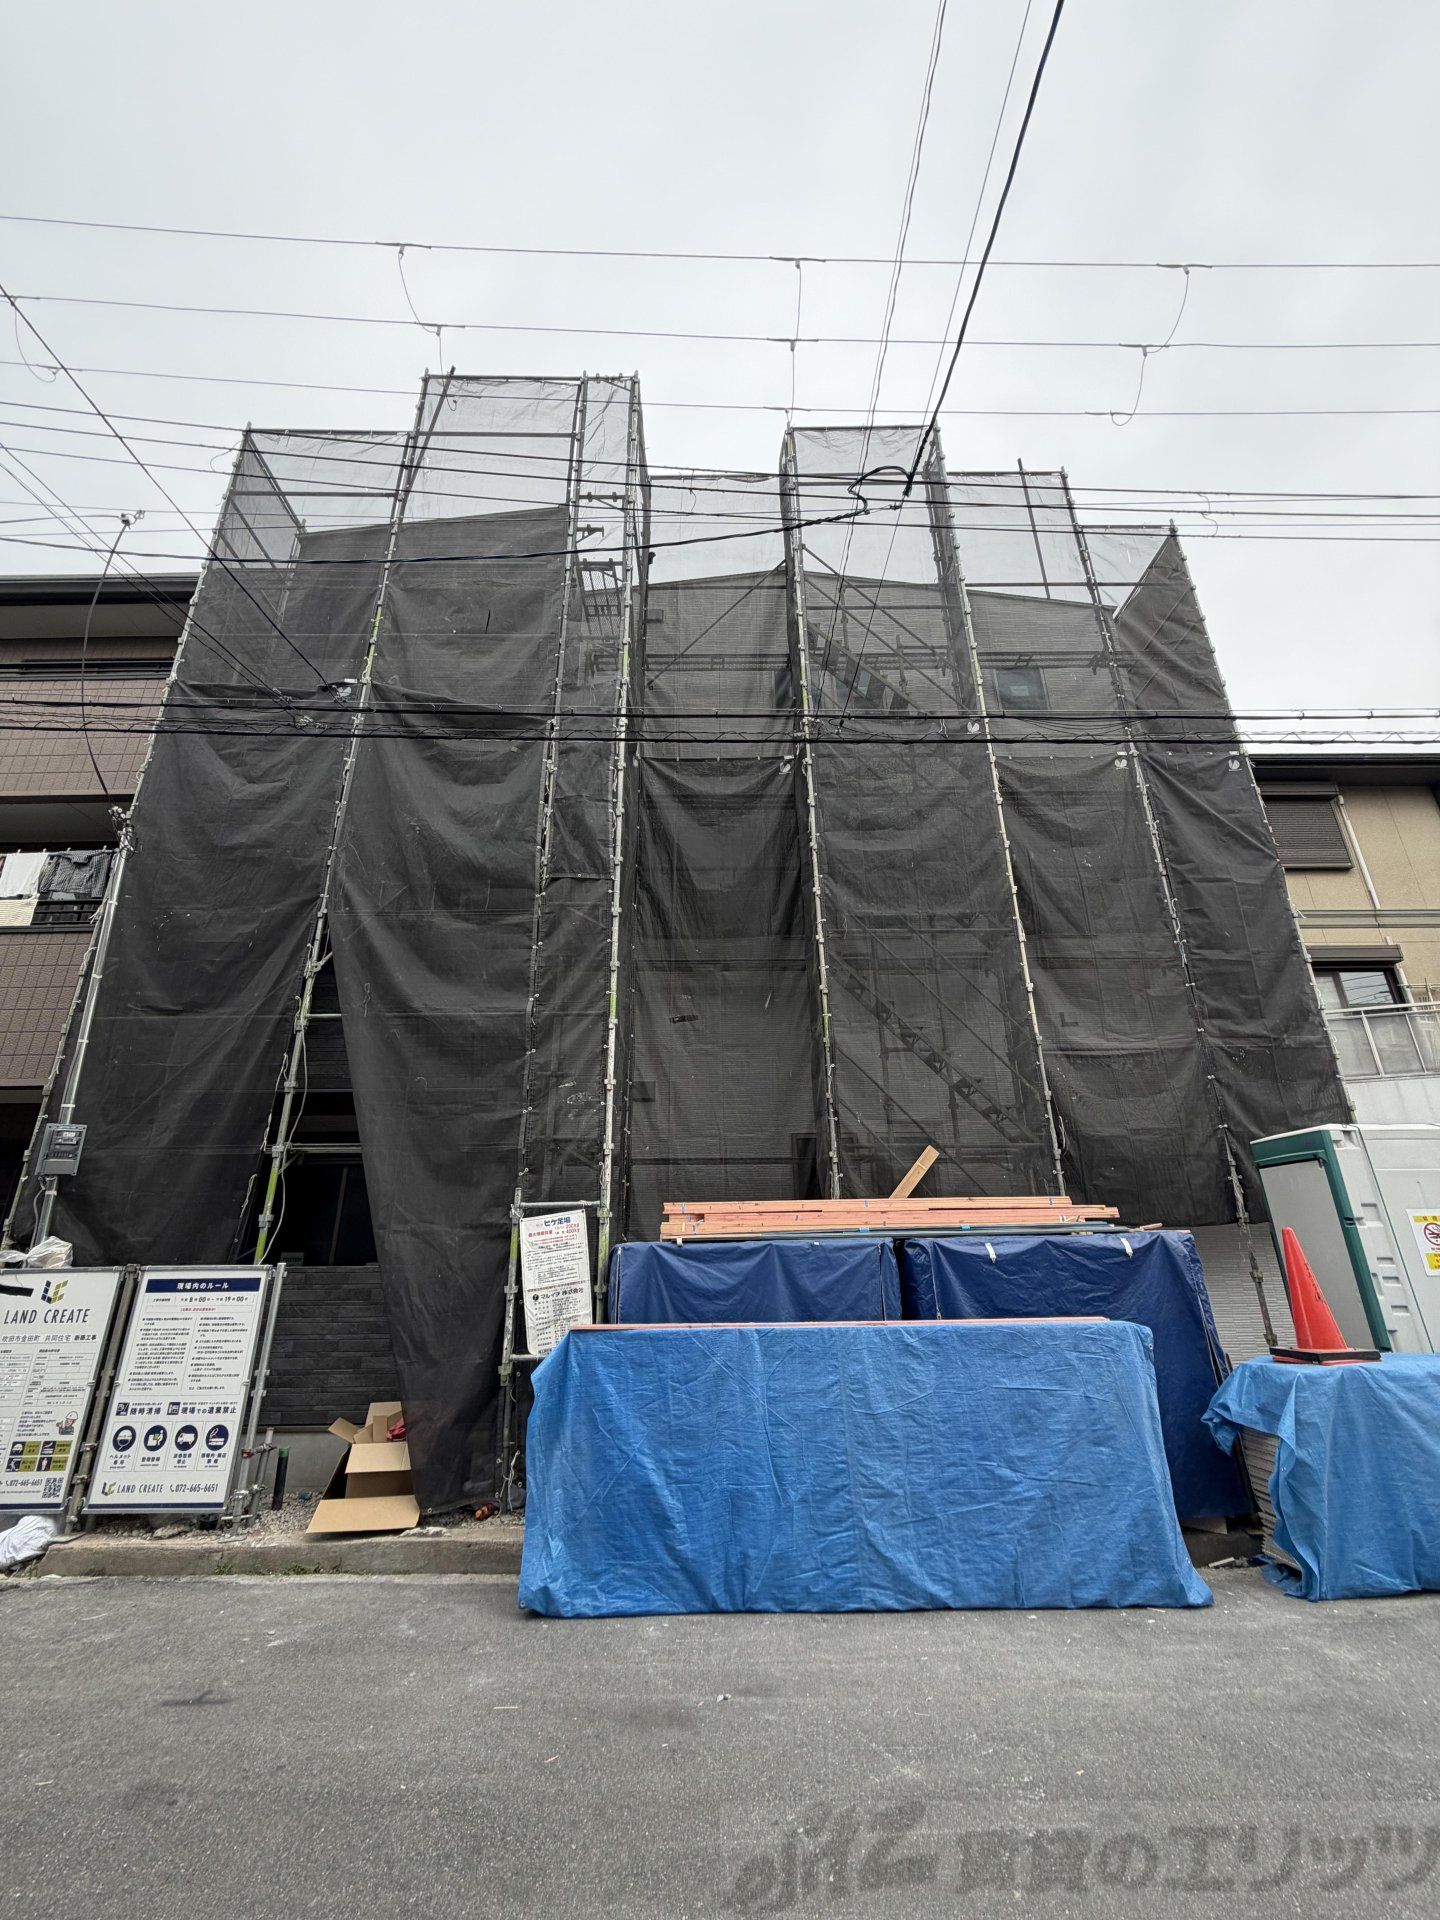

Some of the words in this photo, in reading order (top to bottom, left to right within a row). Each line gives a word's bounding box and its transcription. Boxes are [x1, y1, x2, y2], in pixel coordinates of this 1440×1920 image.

[176, 1282, 229, 1290] 現場内のルール
[3, 1309, 37, 1325] LAND
[43, 1308, 91, 1324] CREATE
[117, 1484, 136, 1494] LAND
[138, 1483, 163, 1494] CREATE
[174, 1483, 219, 1493] 072-665-6651
